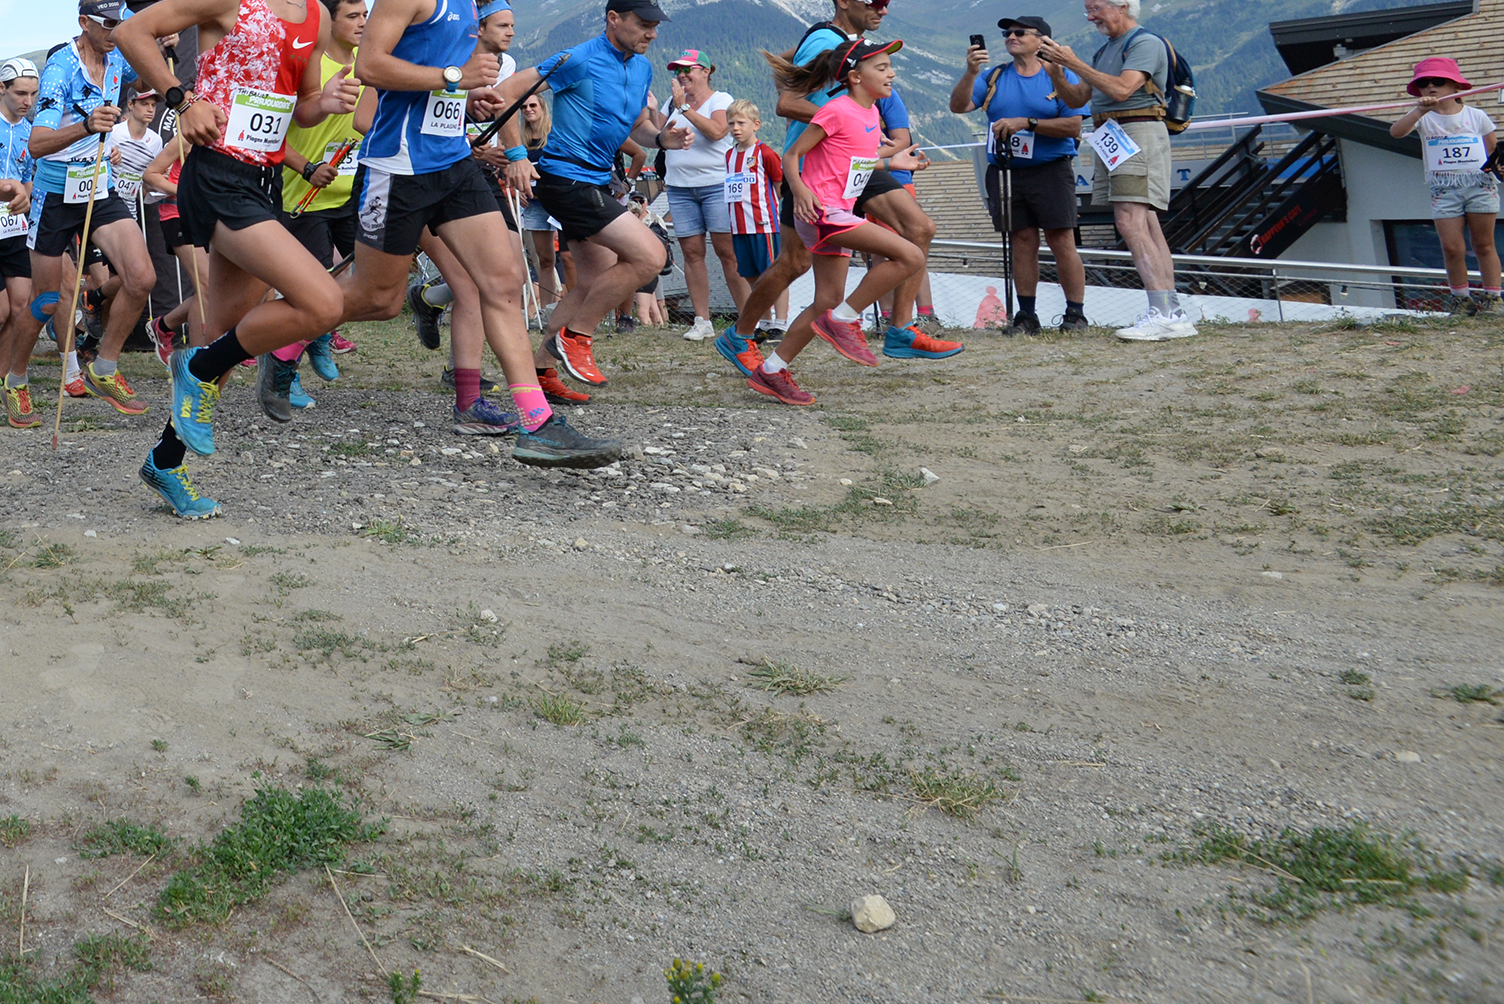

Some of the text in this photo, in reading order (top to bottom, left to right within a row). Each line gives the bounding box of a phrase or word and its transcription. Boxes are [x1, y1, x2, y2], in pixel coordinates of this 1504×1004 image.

[433, 100, 461, 120] 066
[249, 112, 282, 135] 031
[246, 134, 263, 143] Plagne
[1100, 132, 1119, 154] 139
[1442, 146, 1471, 158] 187
[79, 179, 98, 193] 00
[728, 183, 743, 194] 169
